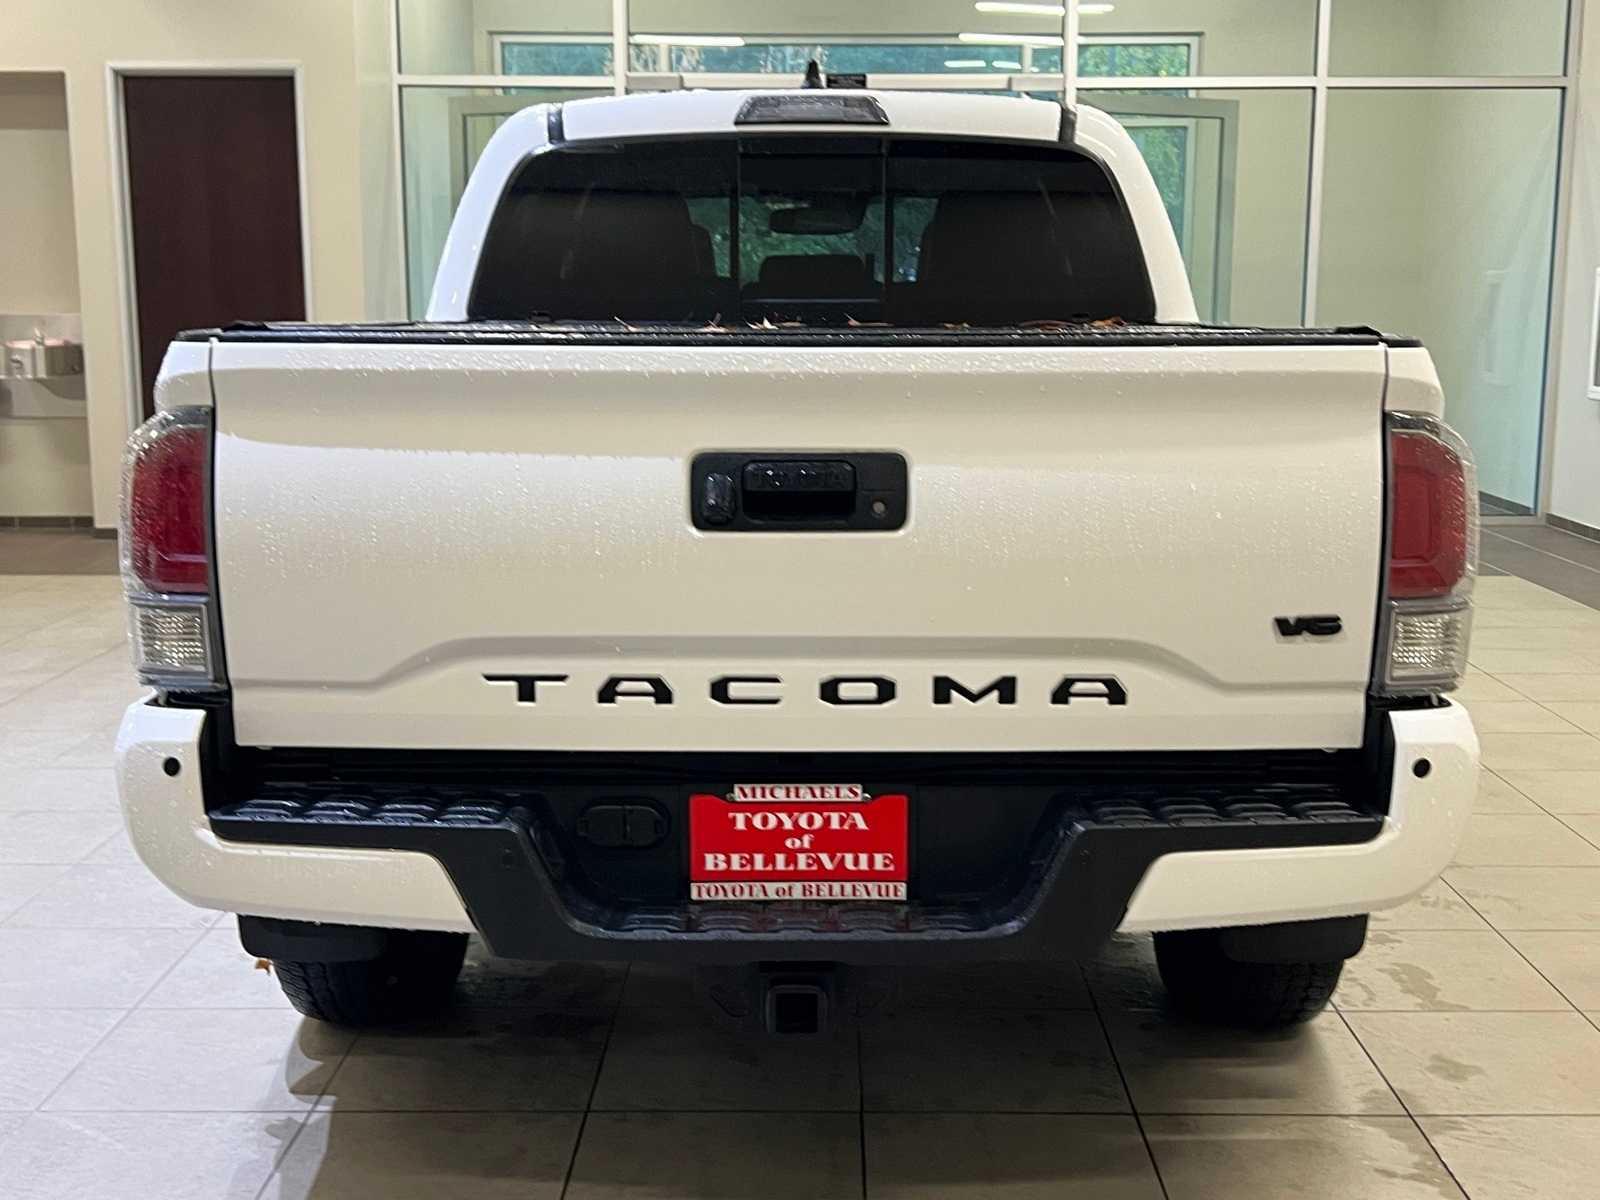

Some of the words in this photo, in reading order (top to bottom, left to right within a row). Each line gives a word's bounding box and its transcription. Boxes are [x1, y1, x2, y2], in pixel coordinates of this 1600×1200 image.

[1274, 615, 1342, 637] V6
[483, 673, 1128, 705] TACOMA
[736, 785, 860, 800] MICHAELS
[728, 812, 868, 830] TOYOTA
[784, 833, 815, 849] of
[704, 853, 895, 871] BELLEVUE
[693, 883, 768, 898] TOYOTA
[775, 883, 794, 897] of
[801, 883, 904, 898] BELLEVUE
